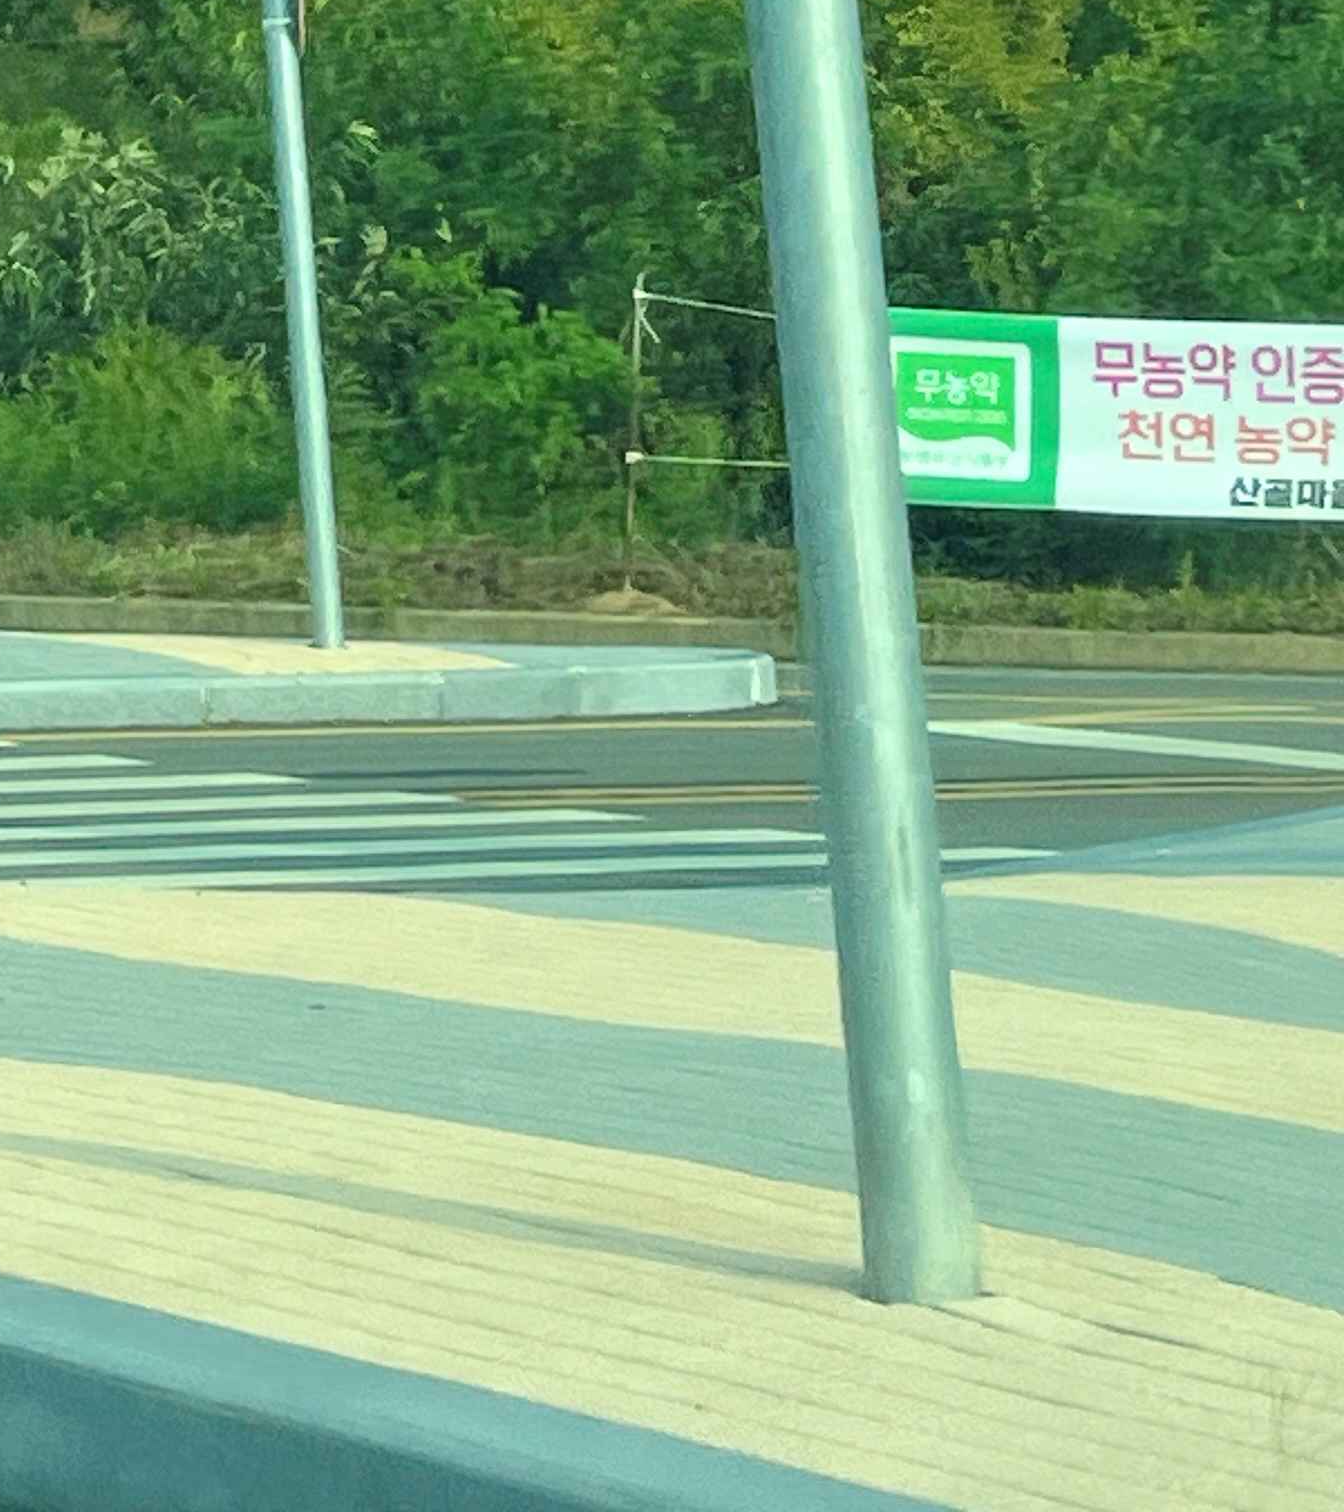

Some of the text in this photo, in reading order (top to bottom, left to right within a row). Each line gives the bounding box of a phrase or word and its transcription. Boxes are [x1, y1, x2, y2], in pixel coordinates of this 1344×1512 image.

[913, 368, 1001, 406] 무농약
[1094, 340, 1344, 405] 무농약 인증
[1118, 408, 1336, 466] 천연 농약
